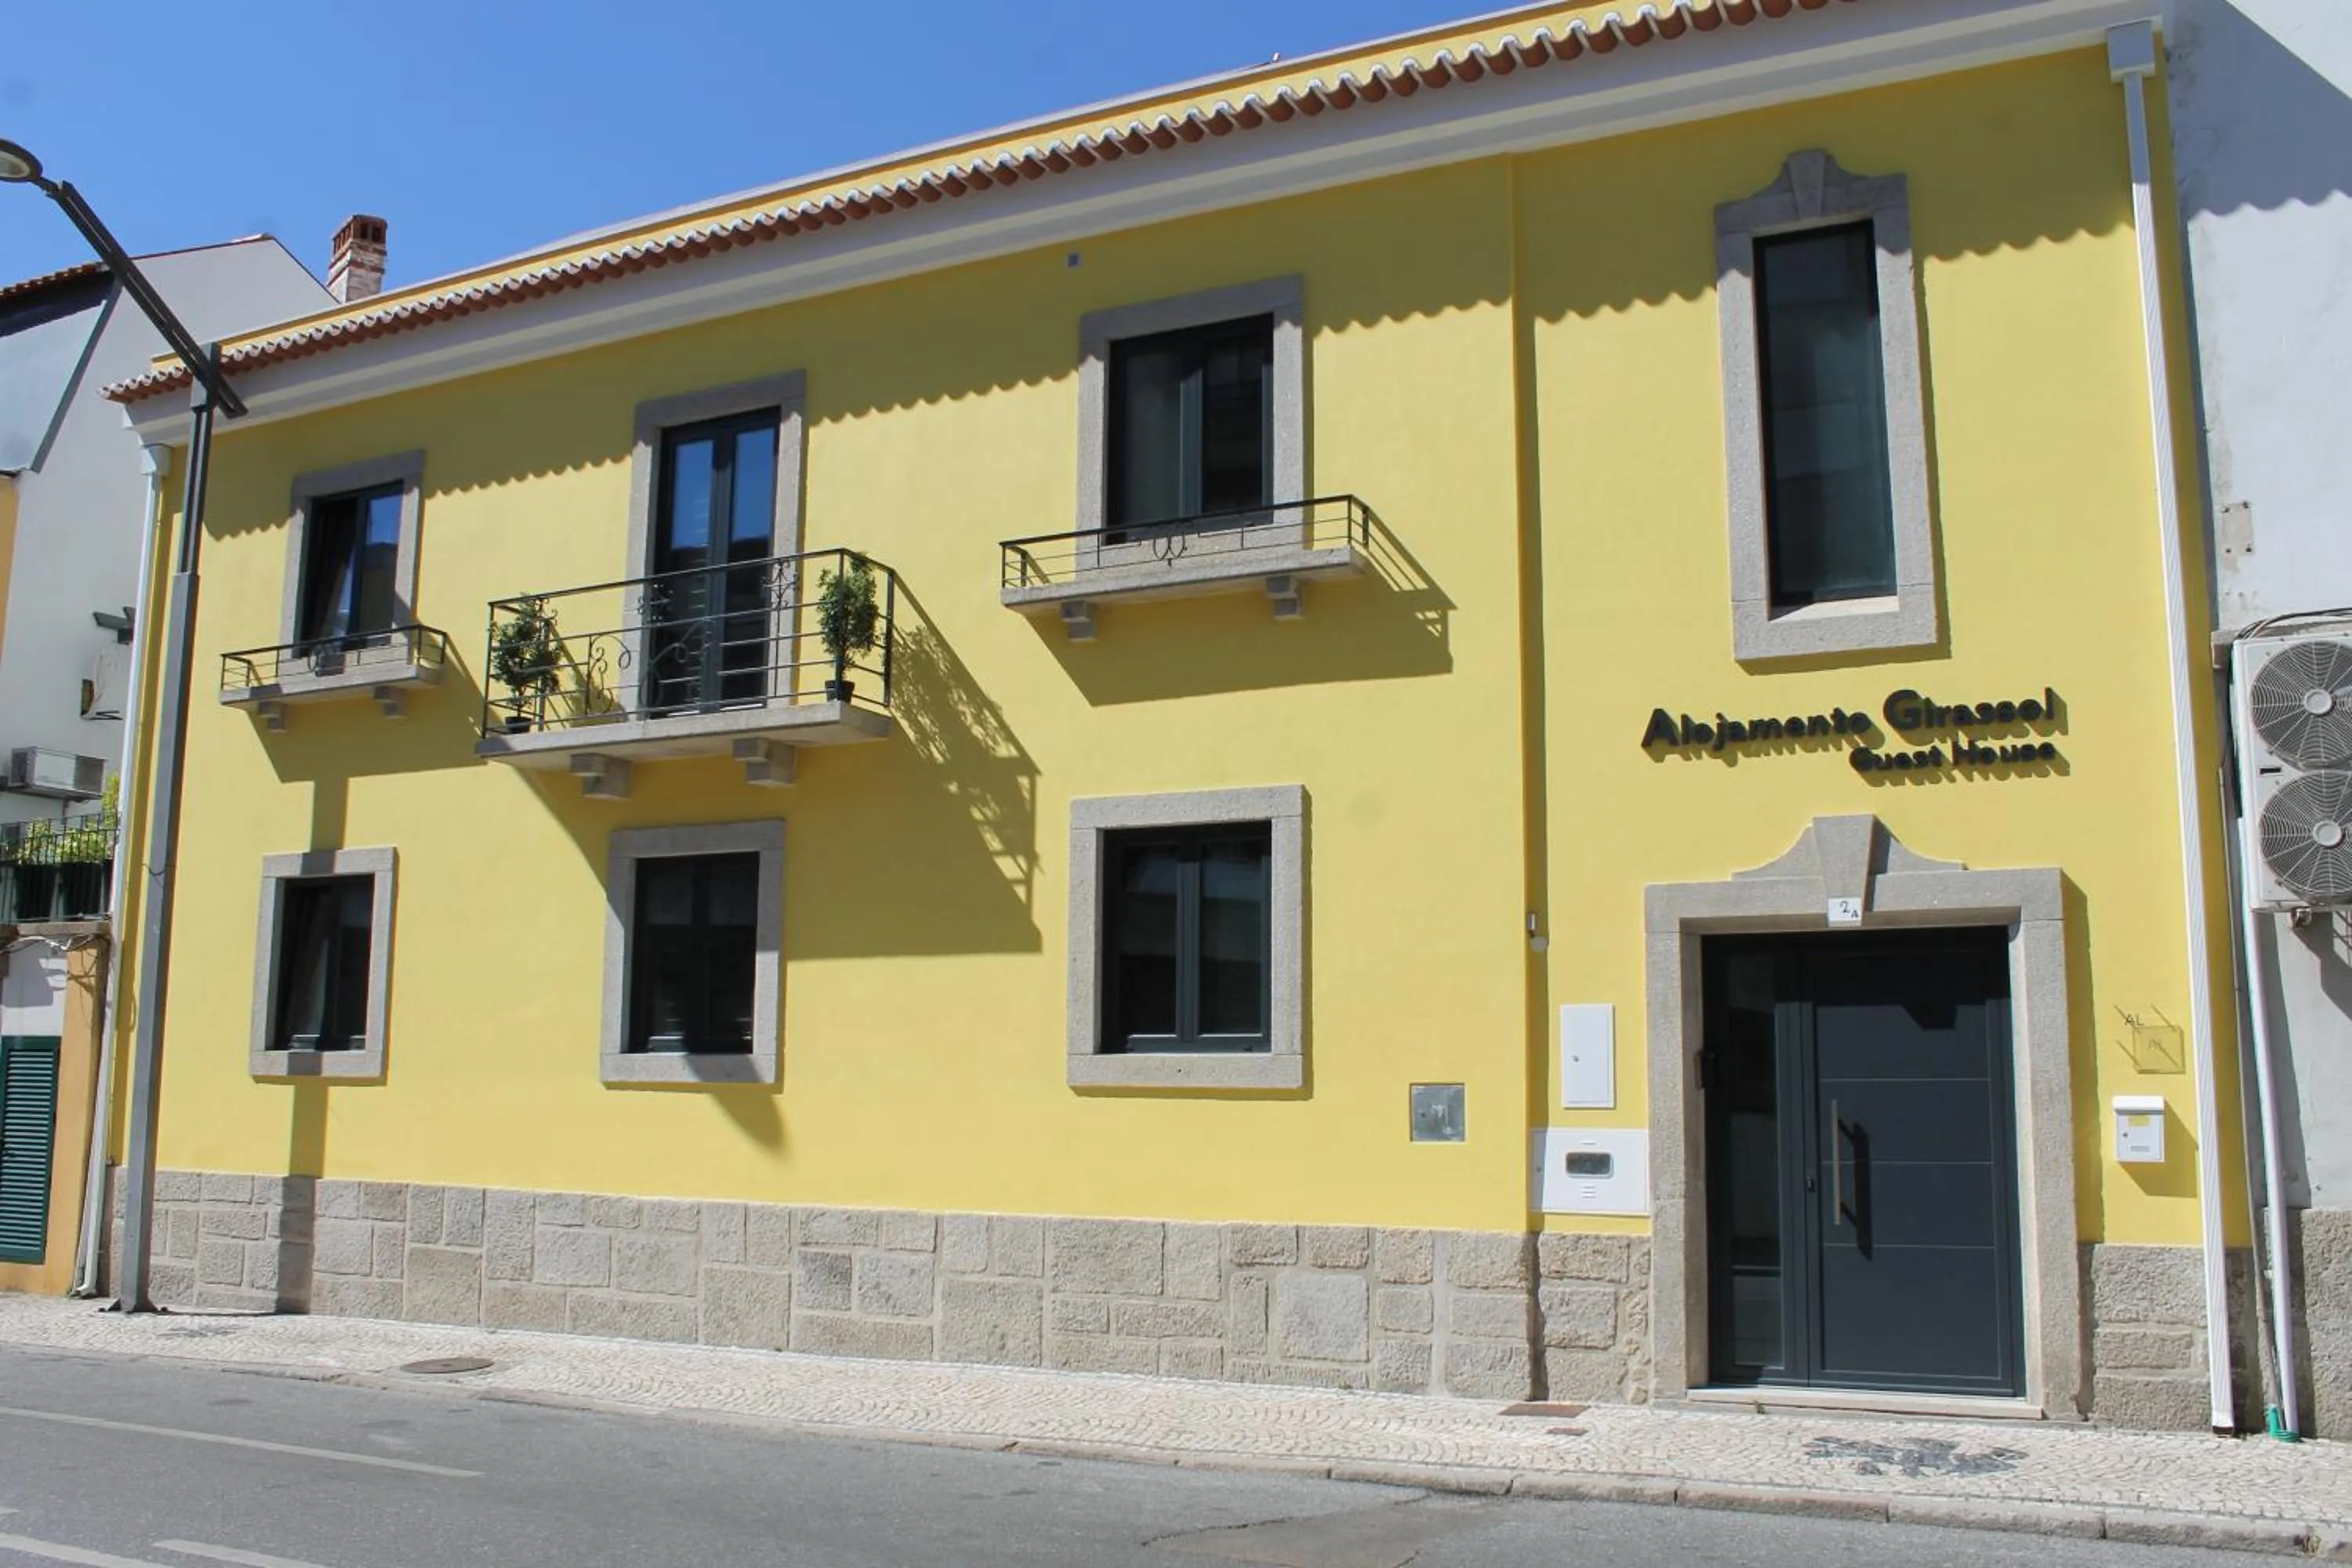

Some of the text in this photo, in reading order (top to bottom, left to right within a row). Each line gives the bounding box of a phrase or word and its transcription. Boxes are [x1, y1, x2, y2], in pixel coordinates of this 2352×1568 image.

[1641, 687, 2056, 752] Alojamento Girassol
[1849, 739, 2056, 772] Guest House
